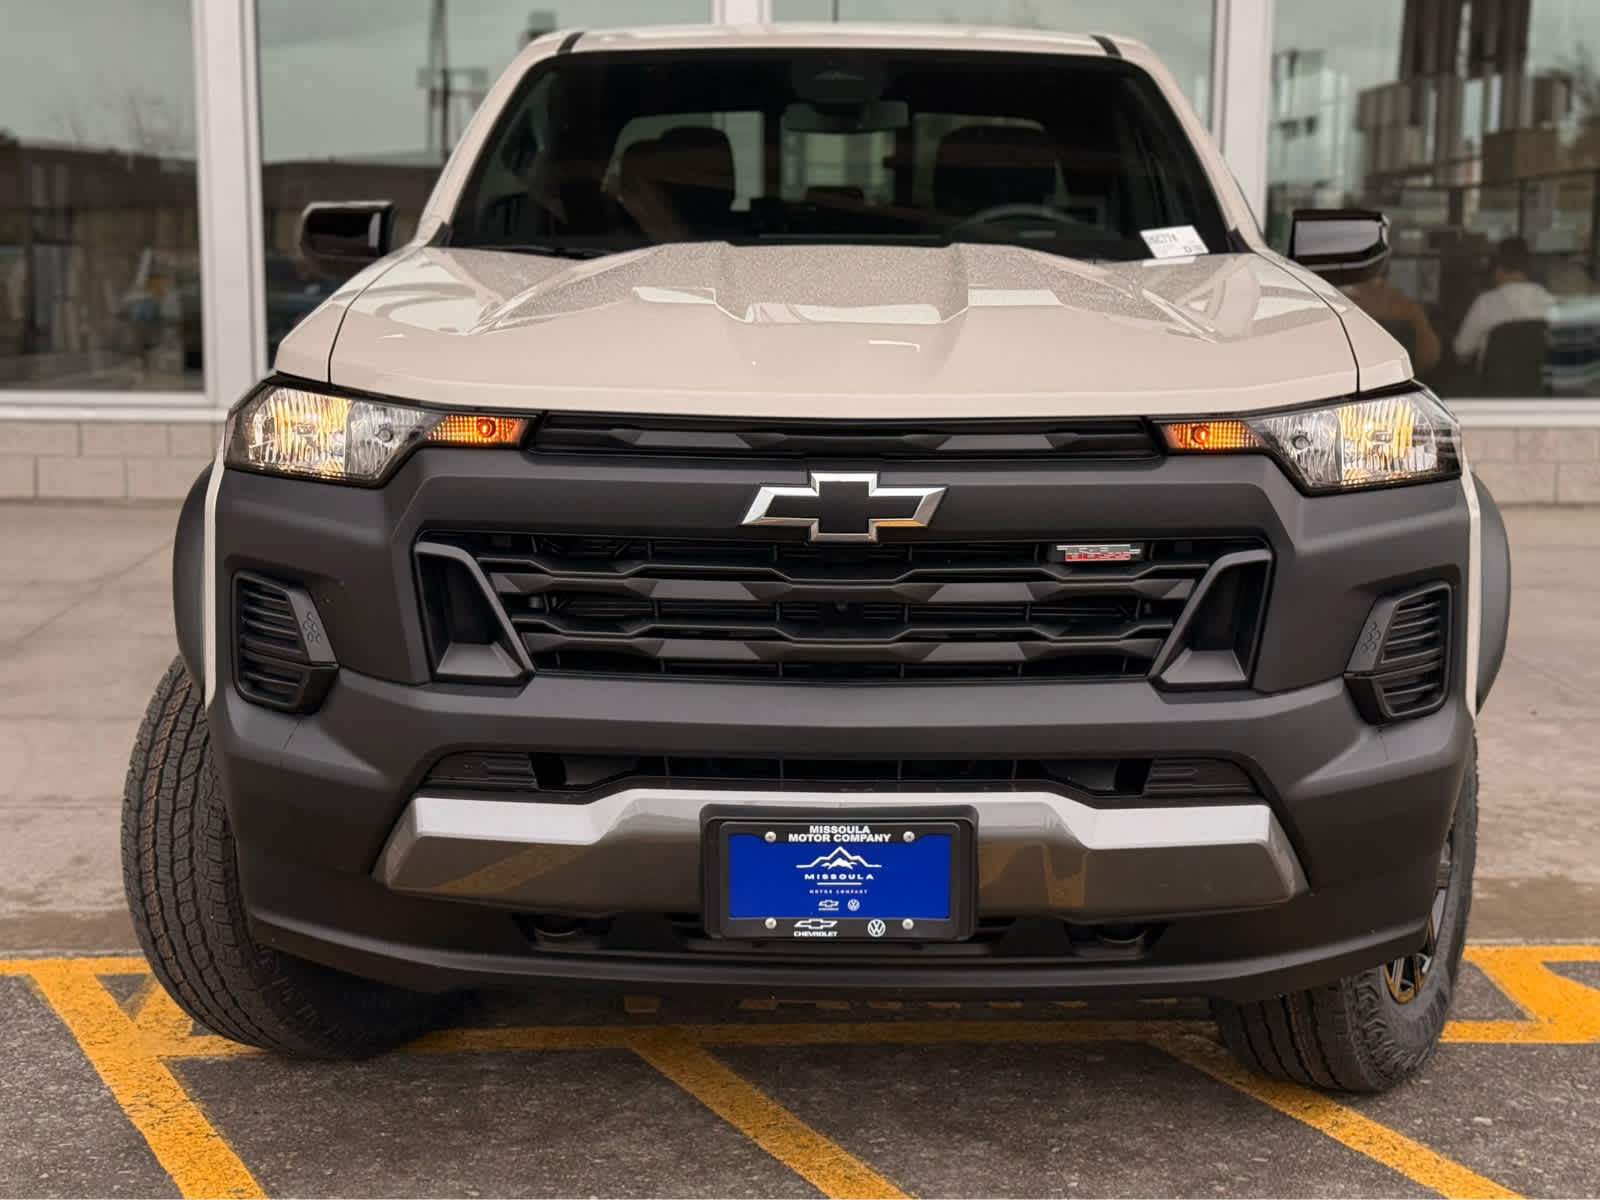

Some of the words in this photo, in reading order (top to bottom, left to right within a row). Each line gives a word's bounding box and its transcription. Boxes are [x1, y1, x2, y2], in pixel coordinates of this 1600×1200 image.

[809, 825, 870, 833] MISSOULA
[788, 834, 831, 842] MOTOR
[833, 834, 891, 842] COMPANY
